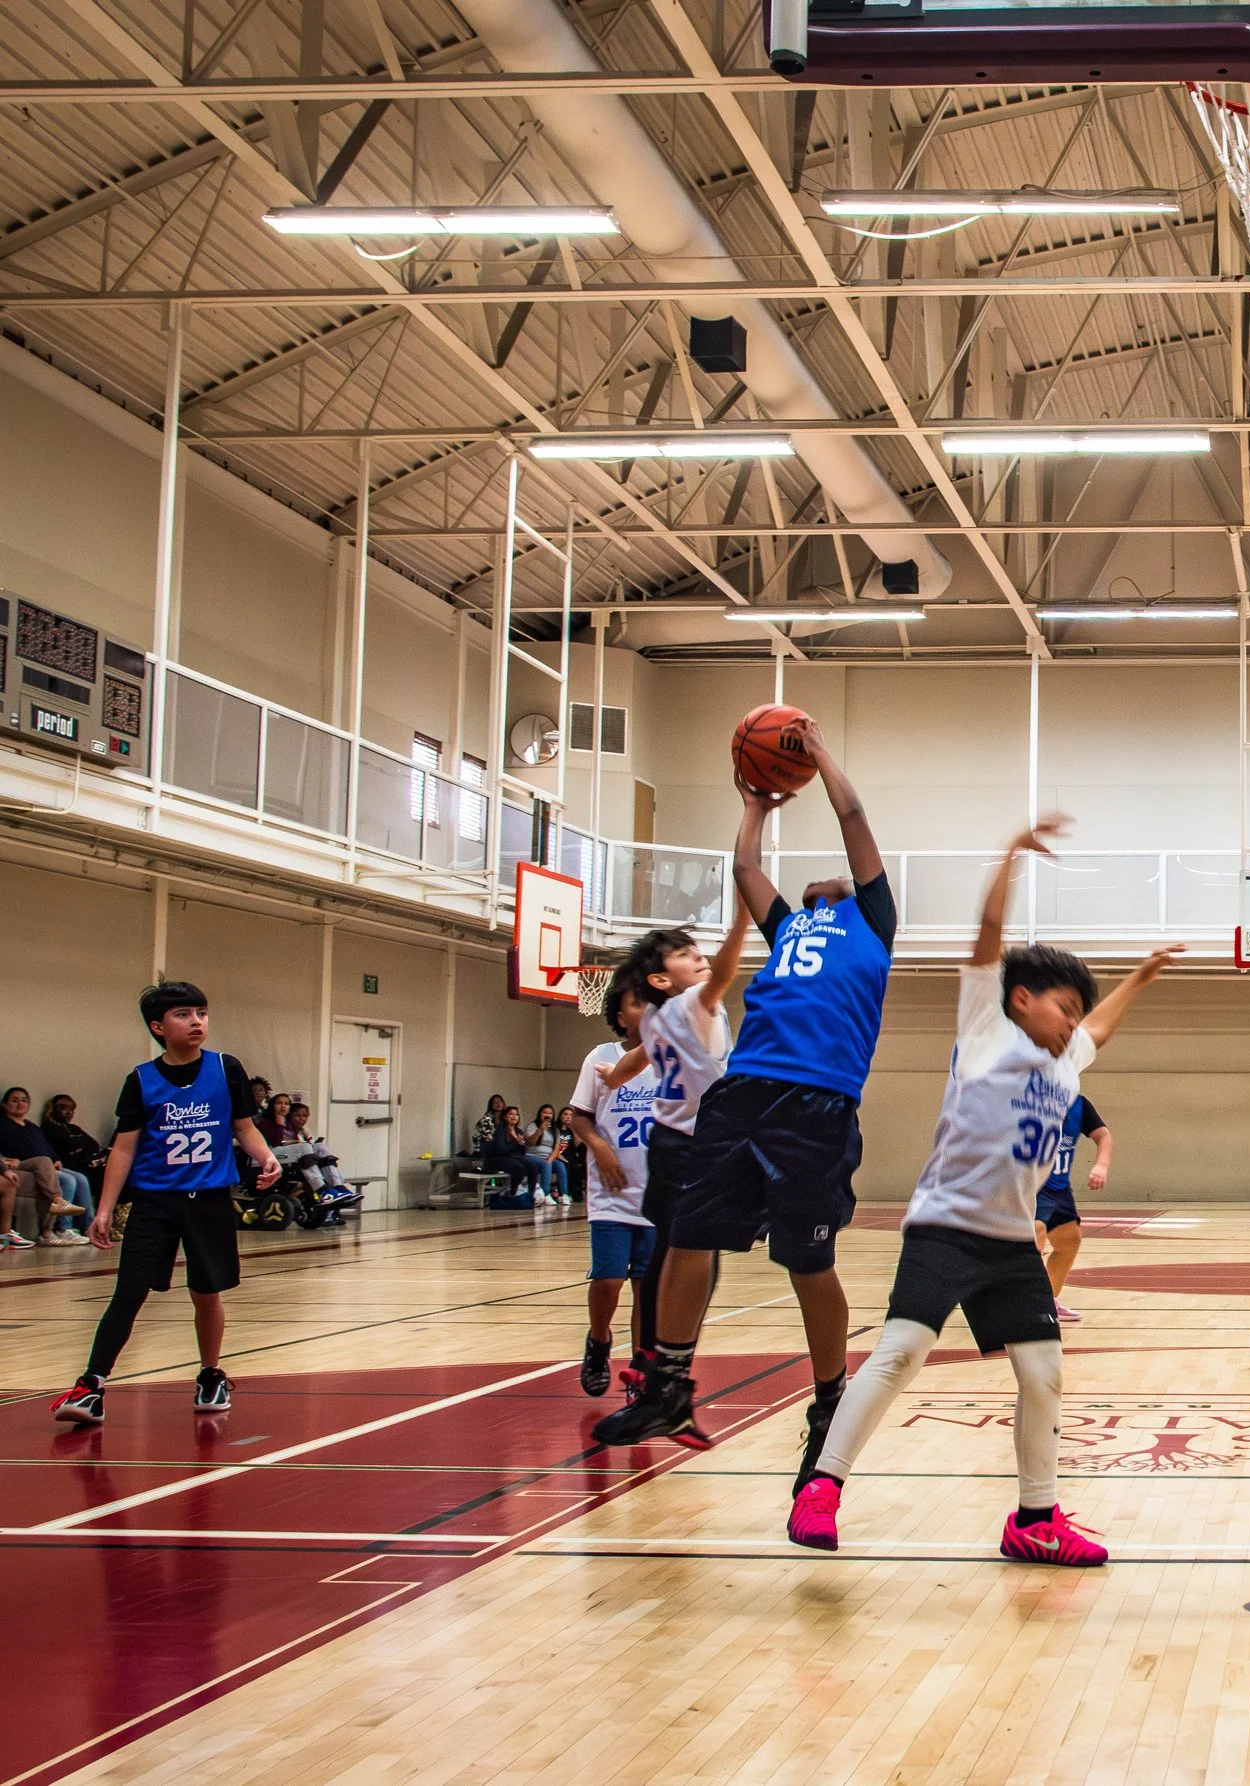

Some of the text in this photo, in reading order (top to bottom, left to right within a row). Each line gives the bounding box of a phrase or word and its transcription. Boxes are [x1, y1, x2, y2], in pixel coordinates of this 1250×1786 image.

[37, 710, 73, 738] period
[775, 936, 827, 978] 15
[653, 1044, 686, 1100] 12
[616, 1085, 656, 1104] Rowlet
[163, 1102, 211, 1121] Rowlett
[166, 1130, 212, 1165] 22
[1012, 1116, 1060, 1167] 30
[1053, 1151, 1070, 1175] 11
